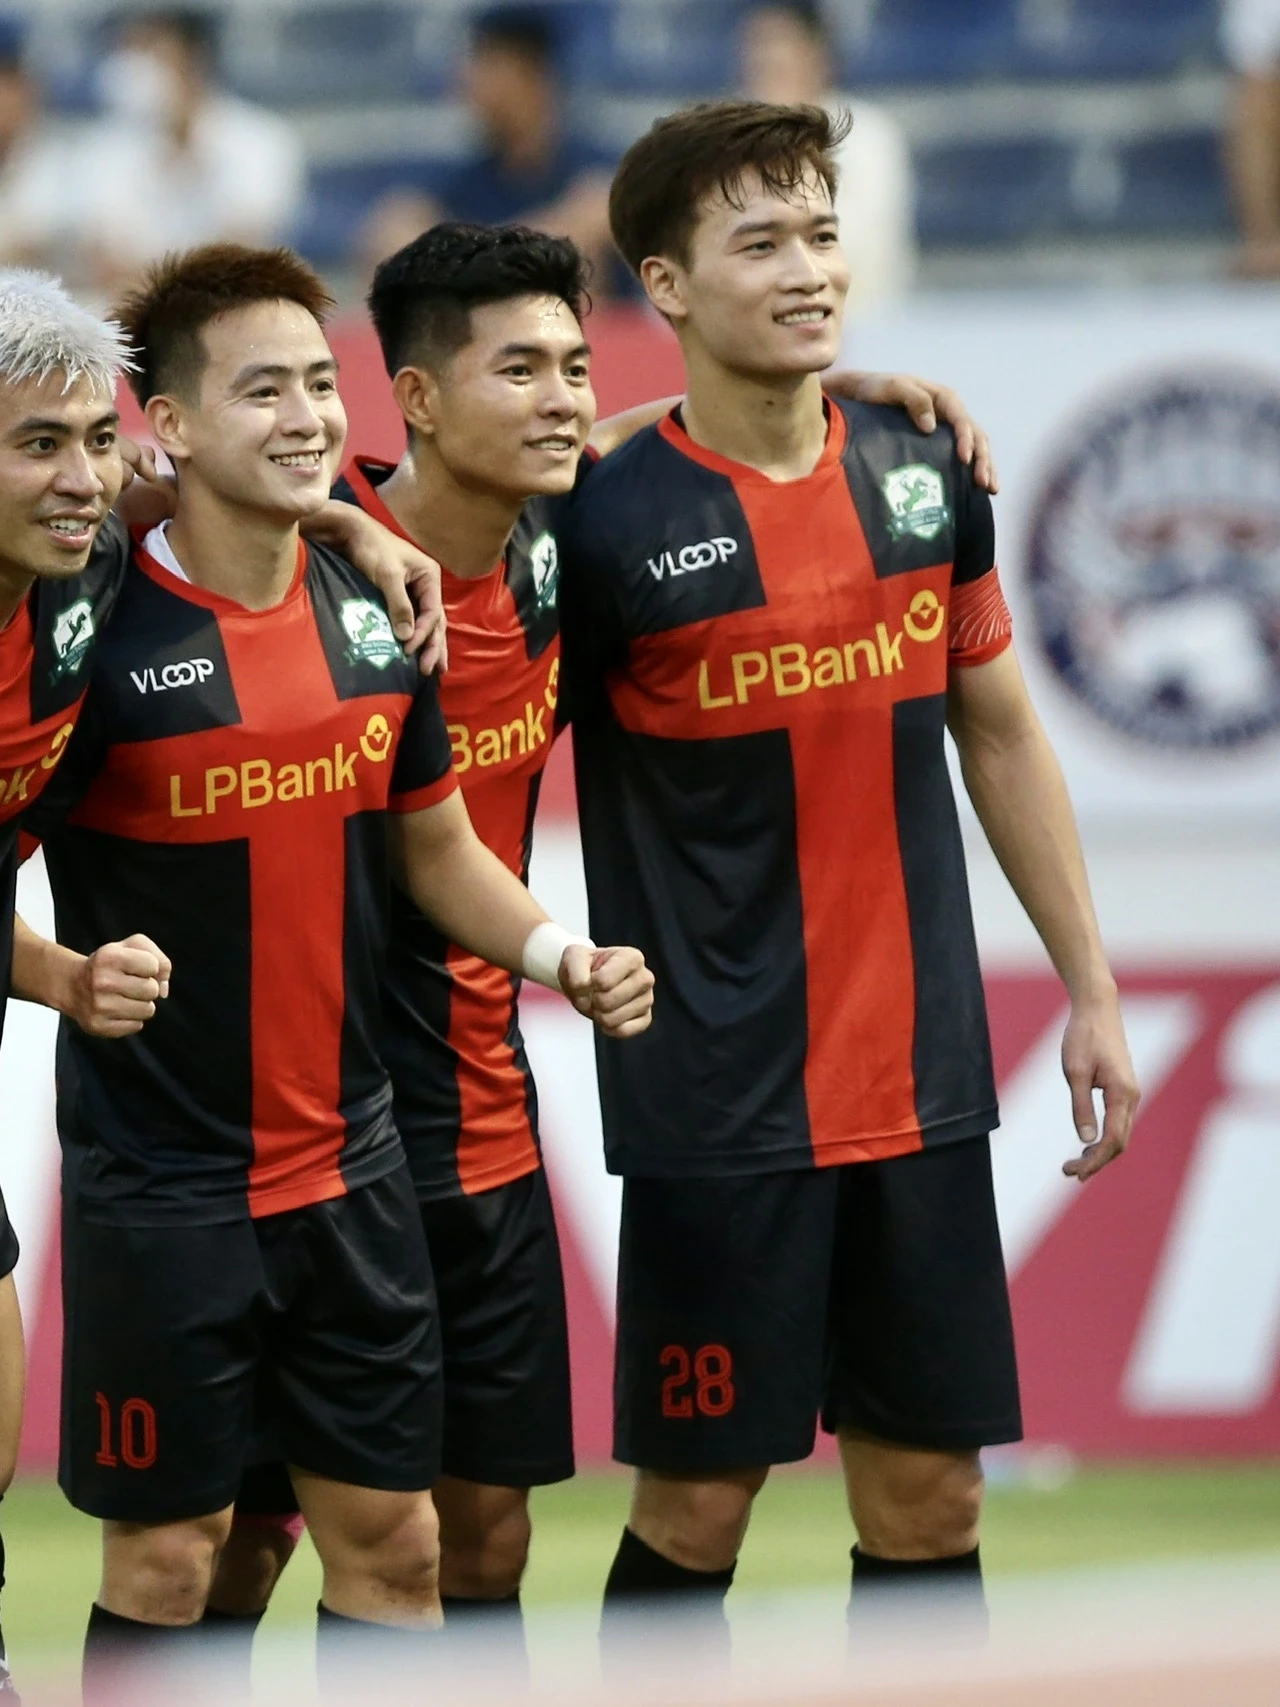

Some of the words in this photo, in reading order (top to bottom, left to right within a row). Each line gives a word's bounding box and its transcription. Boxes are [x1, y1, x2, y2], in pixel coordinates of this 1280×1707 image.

[646, 536, 739, 581] VLOOP
[129, 657, 215, 695] VLOOP
[697, 621, 906, 710] LPBank
[446, 701, 547, 773] Bank
[170, 742, 360, 819] LPBank
[659, 1343, 736, 1419] 28
[95, 1390, 157, 1470] 10
